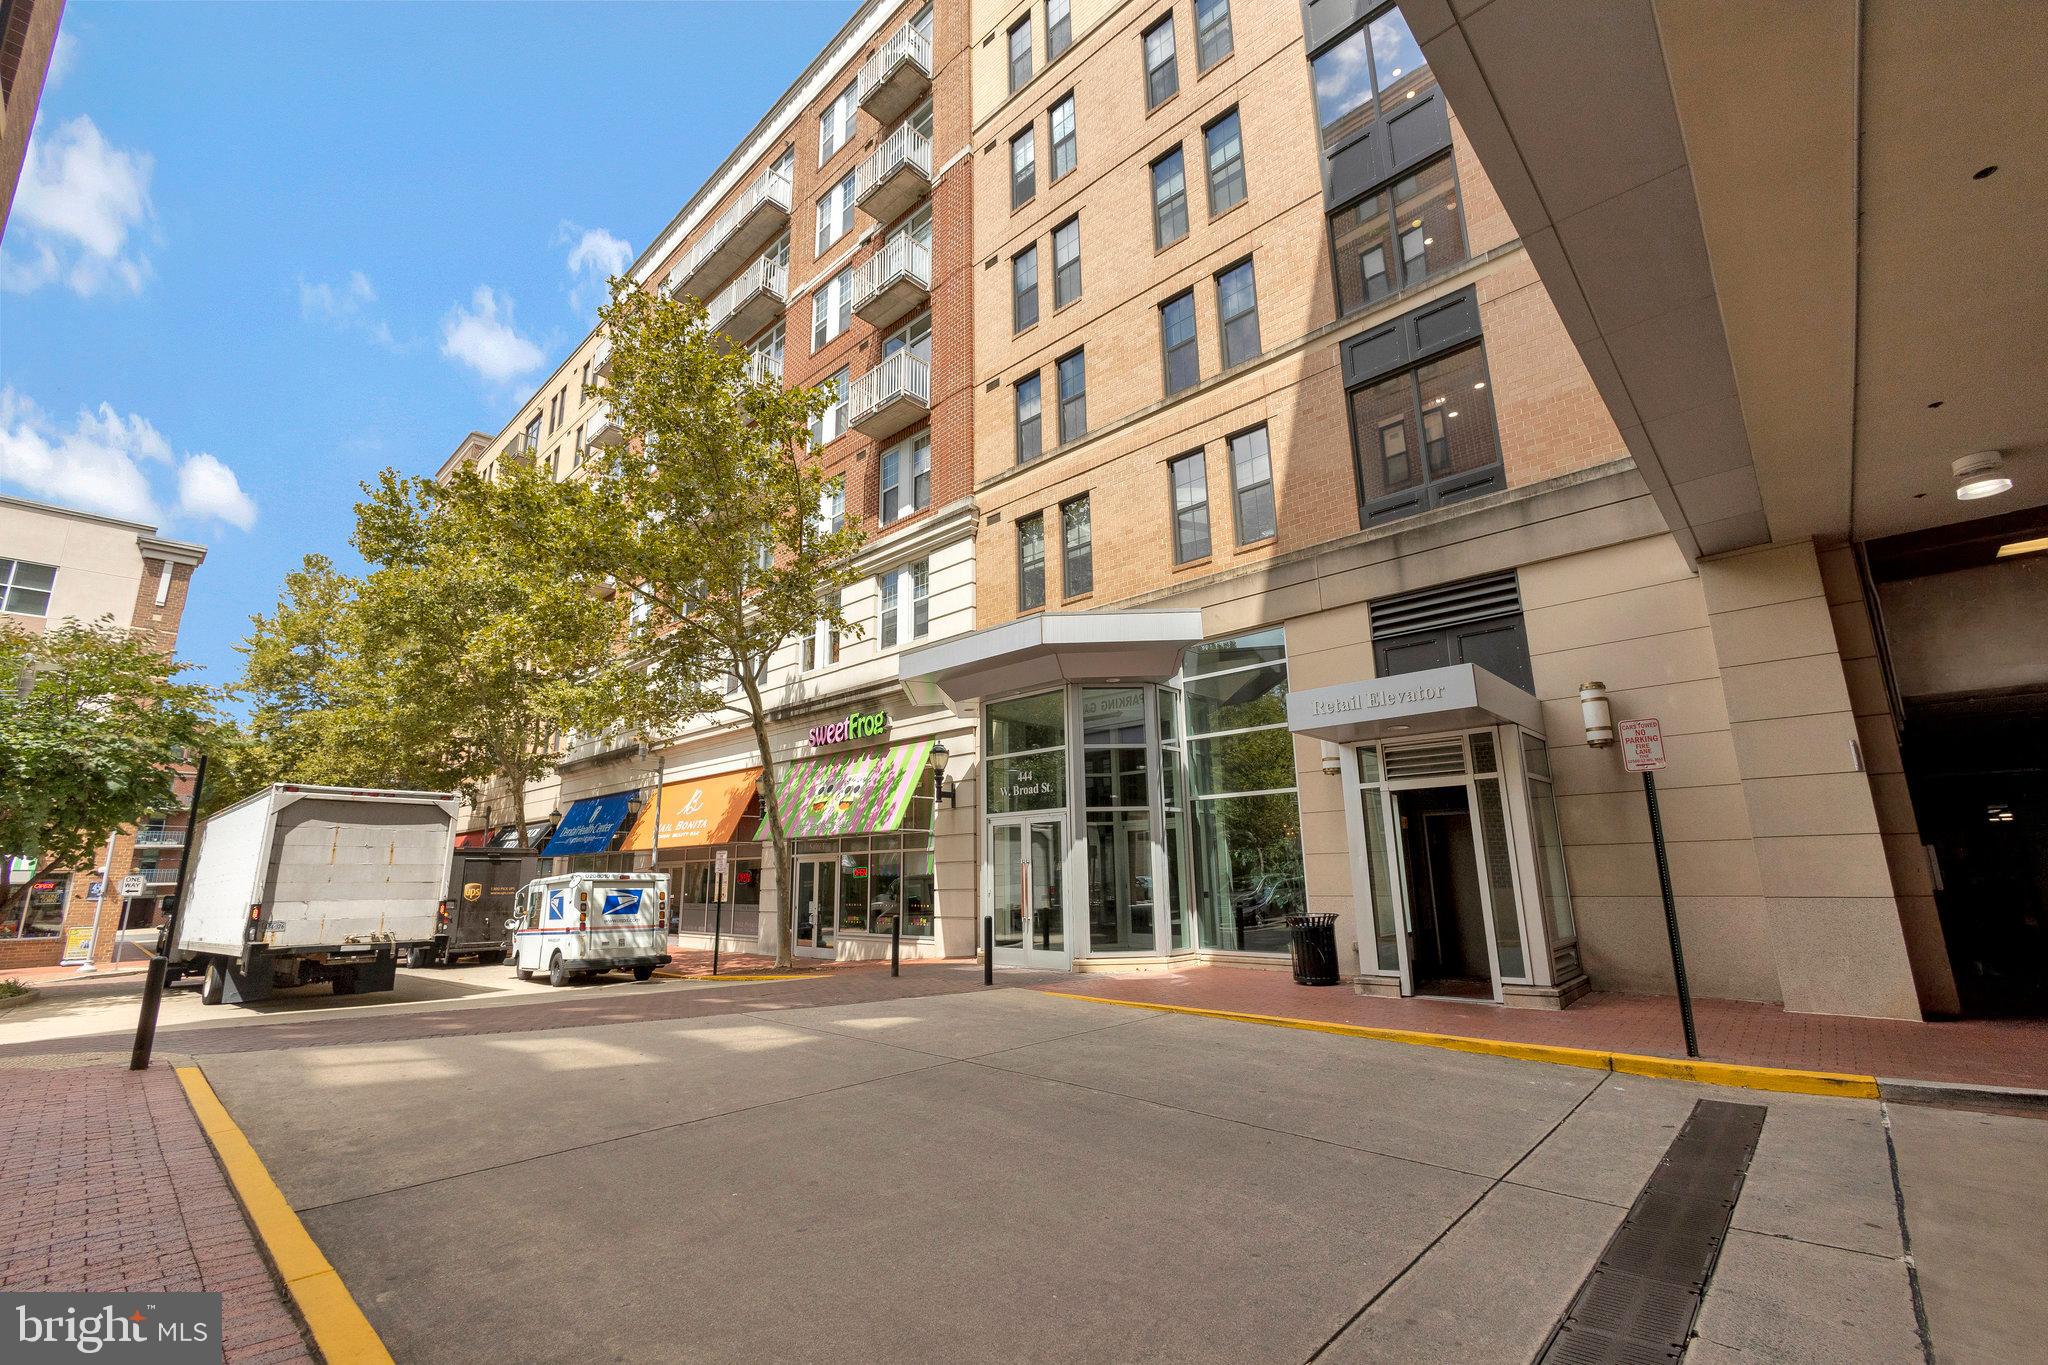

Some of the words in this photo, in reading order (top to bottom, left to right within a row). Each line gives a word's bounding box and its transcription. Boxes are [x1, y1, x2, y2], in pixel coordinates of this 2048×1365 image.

[1312, 695, 1362, 716] Retail
[1366, 685, 1445, 709] Elevator
[809, 710, 884, 747] sweetFrog
[1625, 735, 1659, 744] PARKING
[1017, 771, 1033, 782] 444
[1000, 786, 1011, 796] W.
[1013, 783, 1039, 796] Broad
[1041, 782, 1053, 793] St.
[675, 819, 708, 831] BONITA
[465, 888, 481, 899] ups
